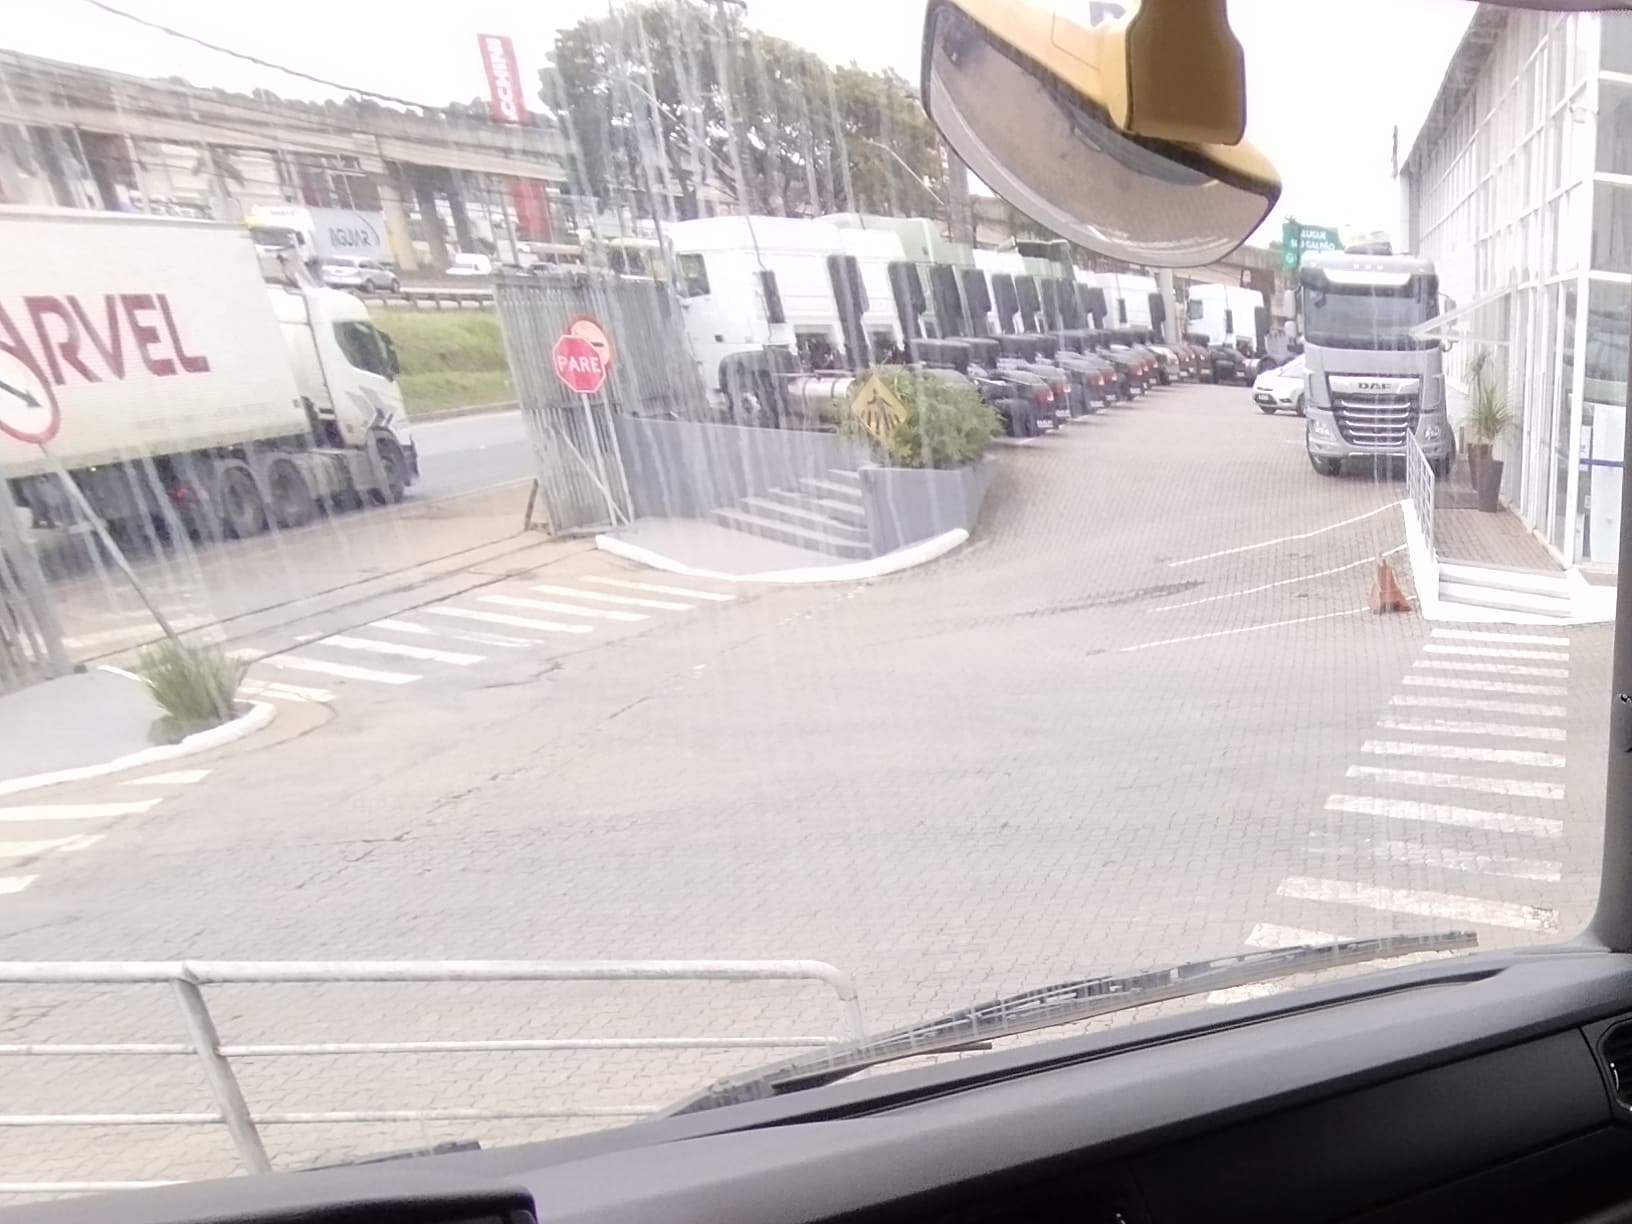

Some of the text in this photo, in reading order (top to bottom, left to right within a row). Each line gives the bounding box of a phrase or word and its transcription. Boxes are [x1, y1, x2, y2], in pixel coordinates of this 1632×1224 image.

[485, 38, 519, 120] CCHINI
[557, 355, 601, 373] PARE
[1358, 382, 1392, 390] DAF
